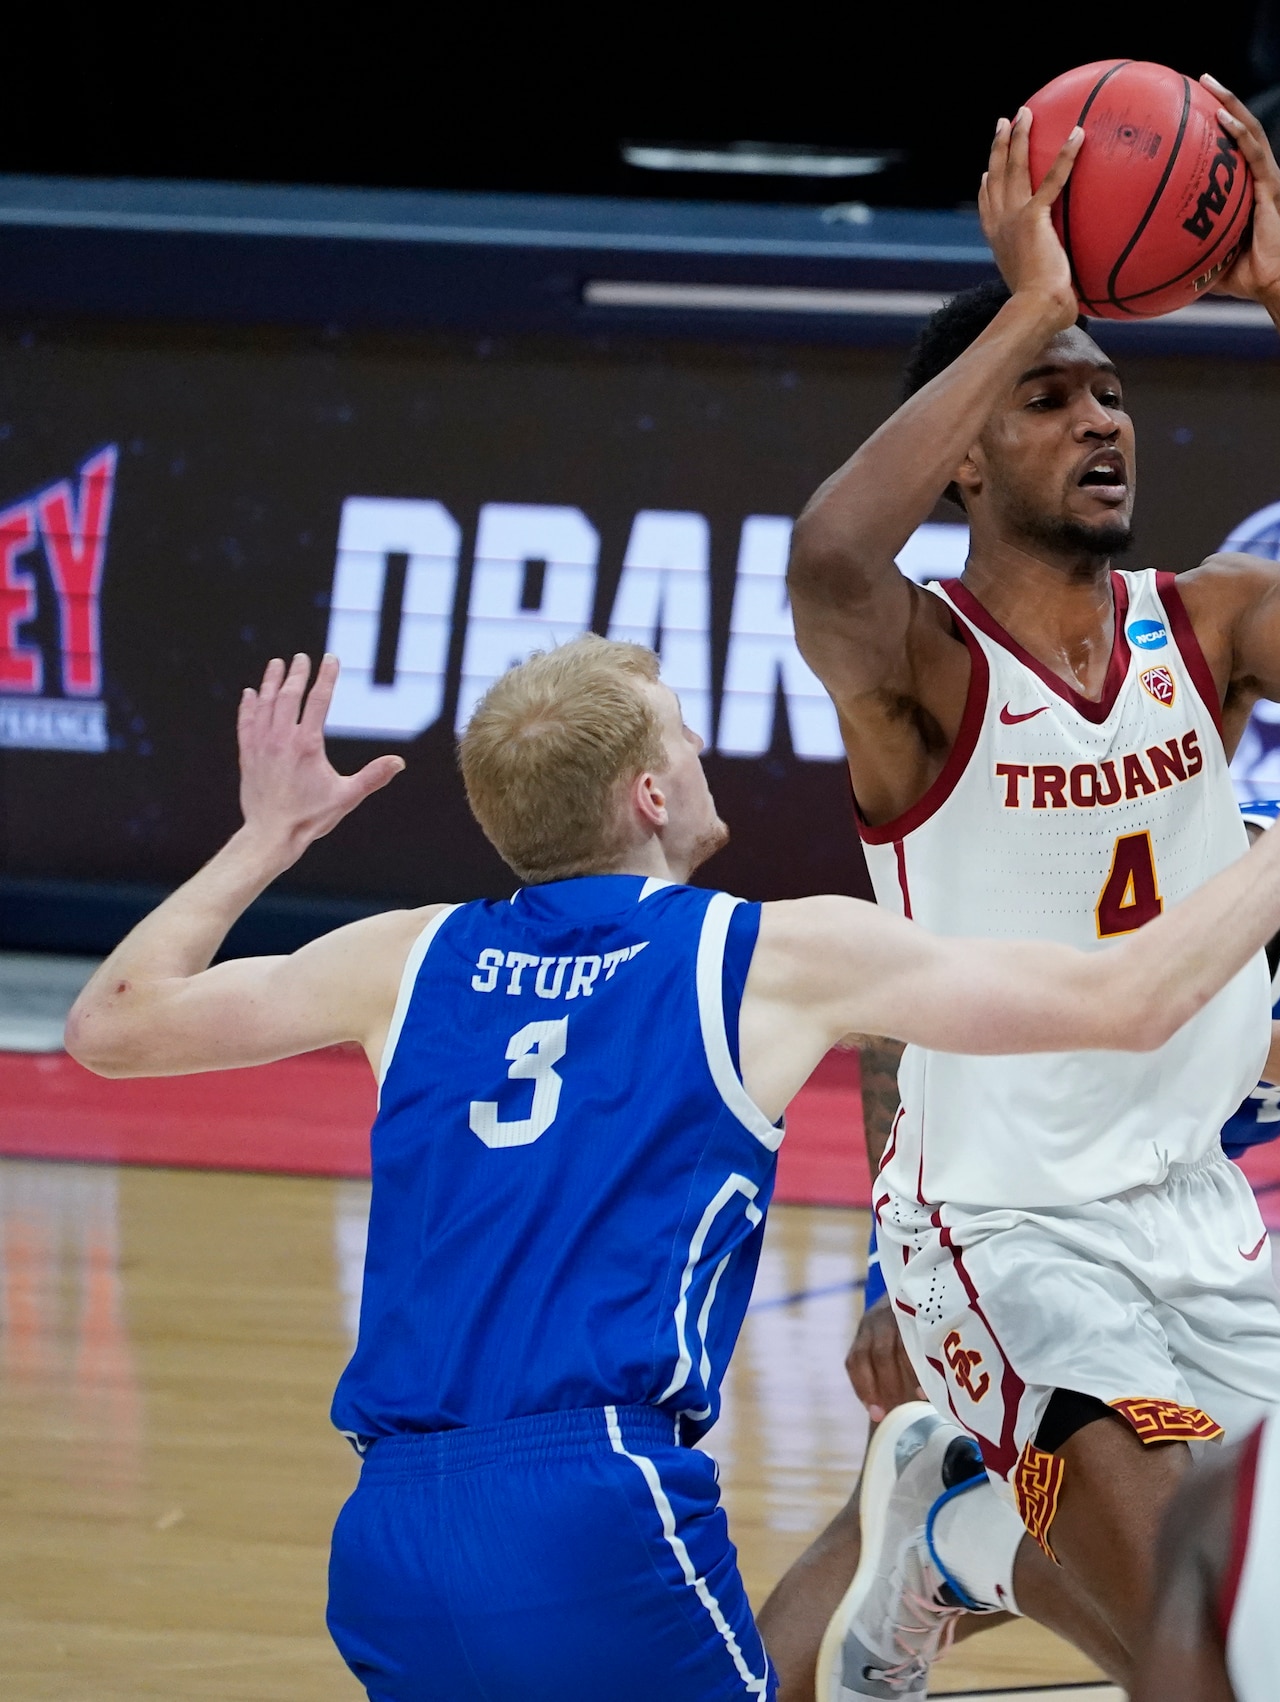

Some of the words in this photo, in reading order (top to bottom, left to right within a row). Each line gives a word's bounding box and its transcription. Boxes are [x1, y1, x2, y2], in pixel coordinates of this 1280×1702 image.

[324, 495, 970, 763] DRAK
[1136, 630, 1166, 644] NCAA
[1142, 667, 1172, 694] PAC
[1154, 684, 1172, 700] 12
[995, 728, 1204, 809] TROJANS
[1095, 829, 1164, 940] 4
[468, 1013, 570, 1149] 3
